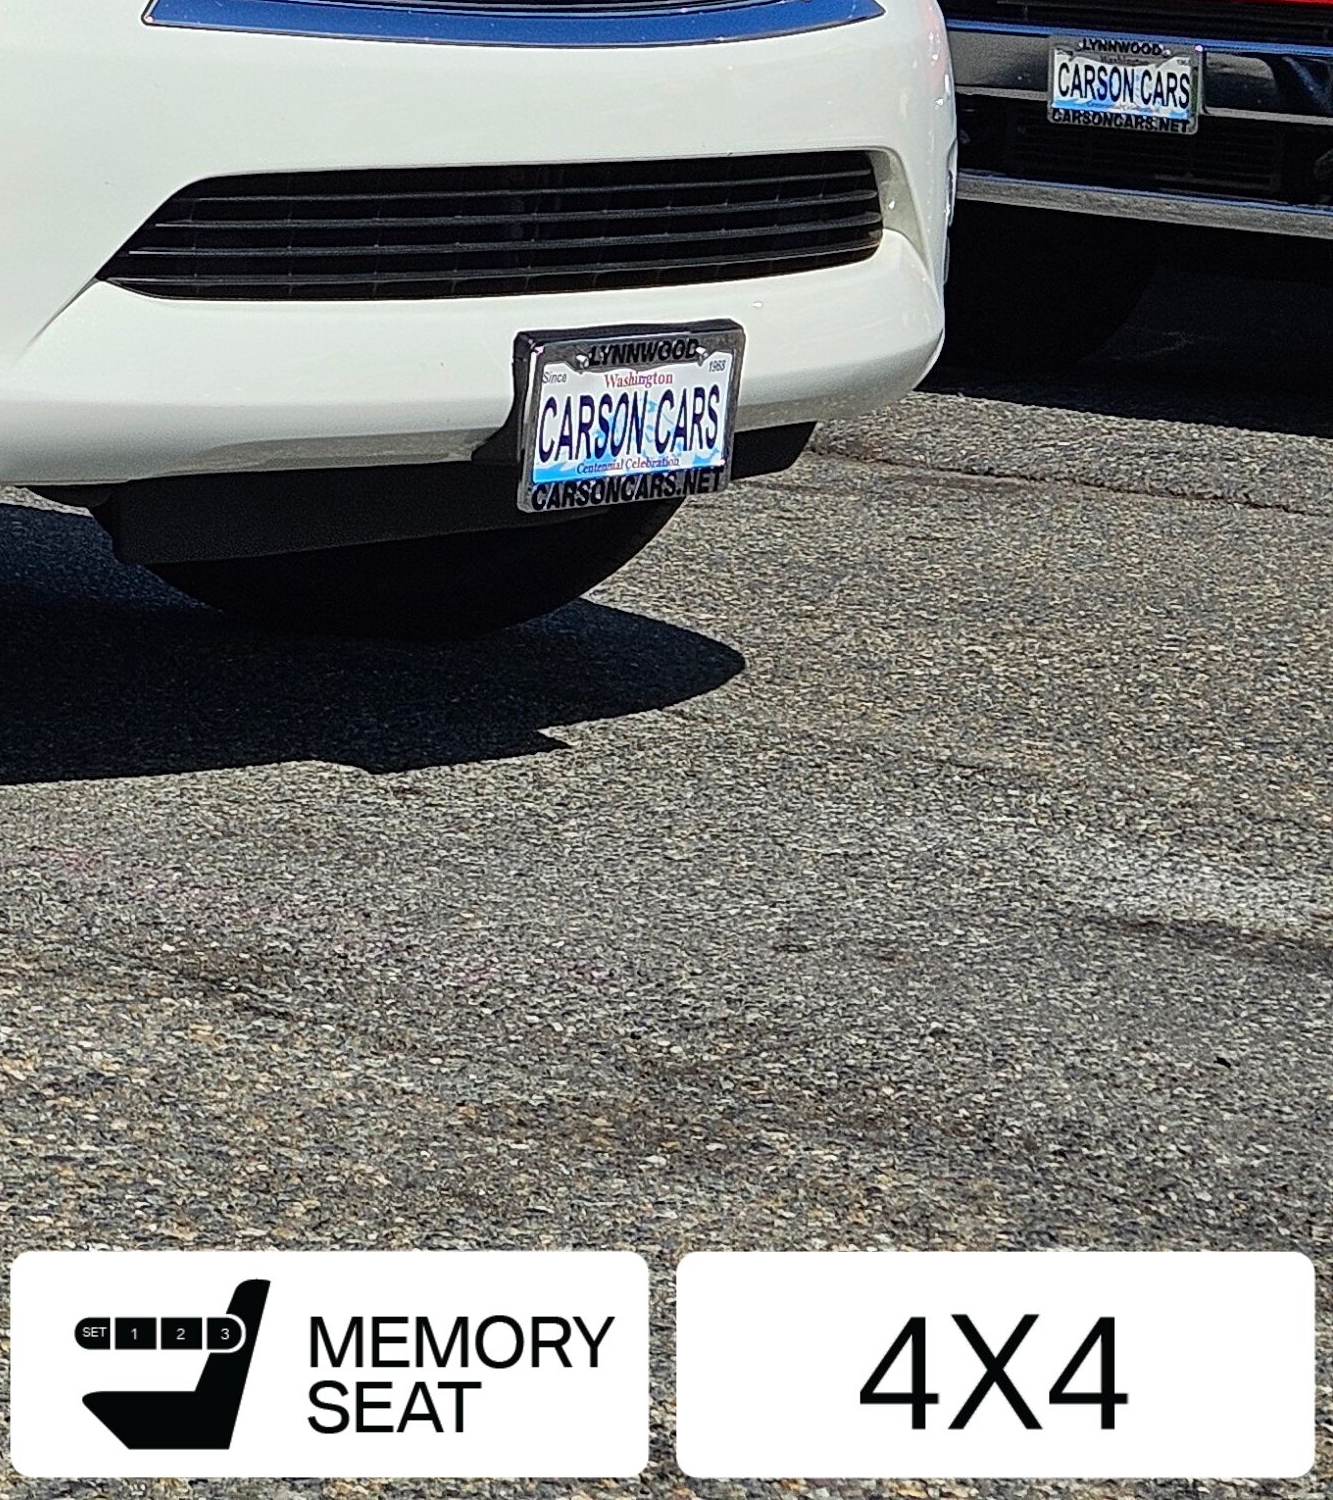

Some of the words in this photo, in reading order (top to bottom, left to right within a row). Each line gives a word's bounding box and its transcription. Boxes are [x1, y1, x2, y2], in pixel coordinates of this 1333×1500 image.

[1082, 38, 1162, 56] LYNNWOOD
[1058, 62, 1134, 103] CARSON
[1141, 69, 1190, 109] CARS
[1052, 109, 1190, 133] CARSONCARS.NET
[589, 338, 699, 366] LYNNWOOD
[604, 371, 673, 389] Washington
[538, 391, 648, 462] CARSON
[655, 384, 720, 454] CARS
[533, 466, 724, 510] CARSONCARS.NET
